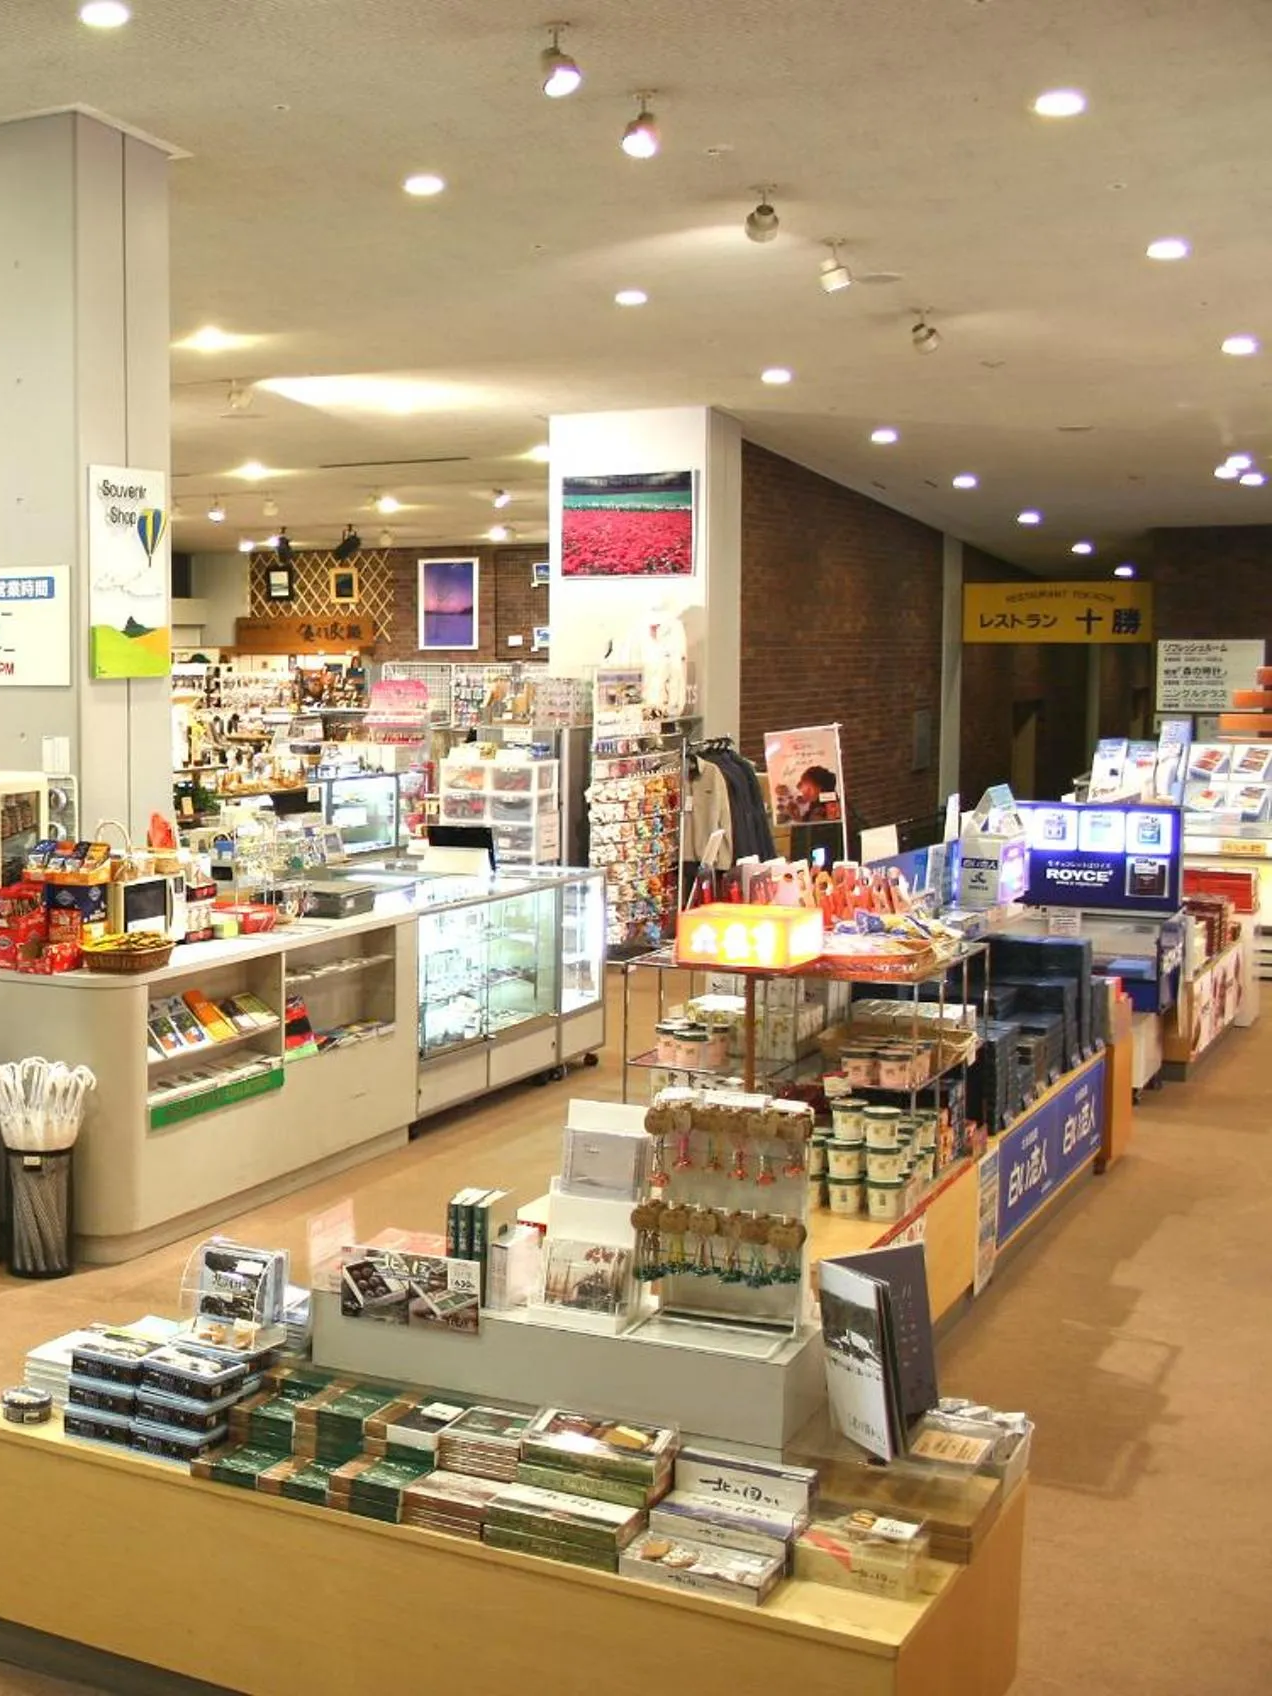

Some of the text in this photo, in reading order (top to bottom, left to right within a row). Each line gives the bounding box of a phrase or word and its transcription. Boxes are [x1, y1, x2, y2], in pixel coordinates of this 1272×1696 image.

[102, 480, 147, 499] Souvenir
[109, 507, 137, 526] Shop
[979, 607, 1142, 635] レストラン 十勝
[1061, 1093, 1096, 1156] 白い恋人
[1007, 1137, 1048, 1210] 白い恋人
